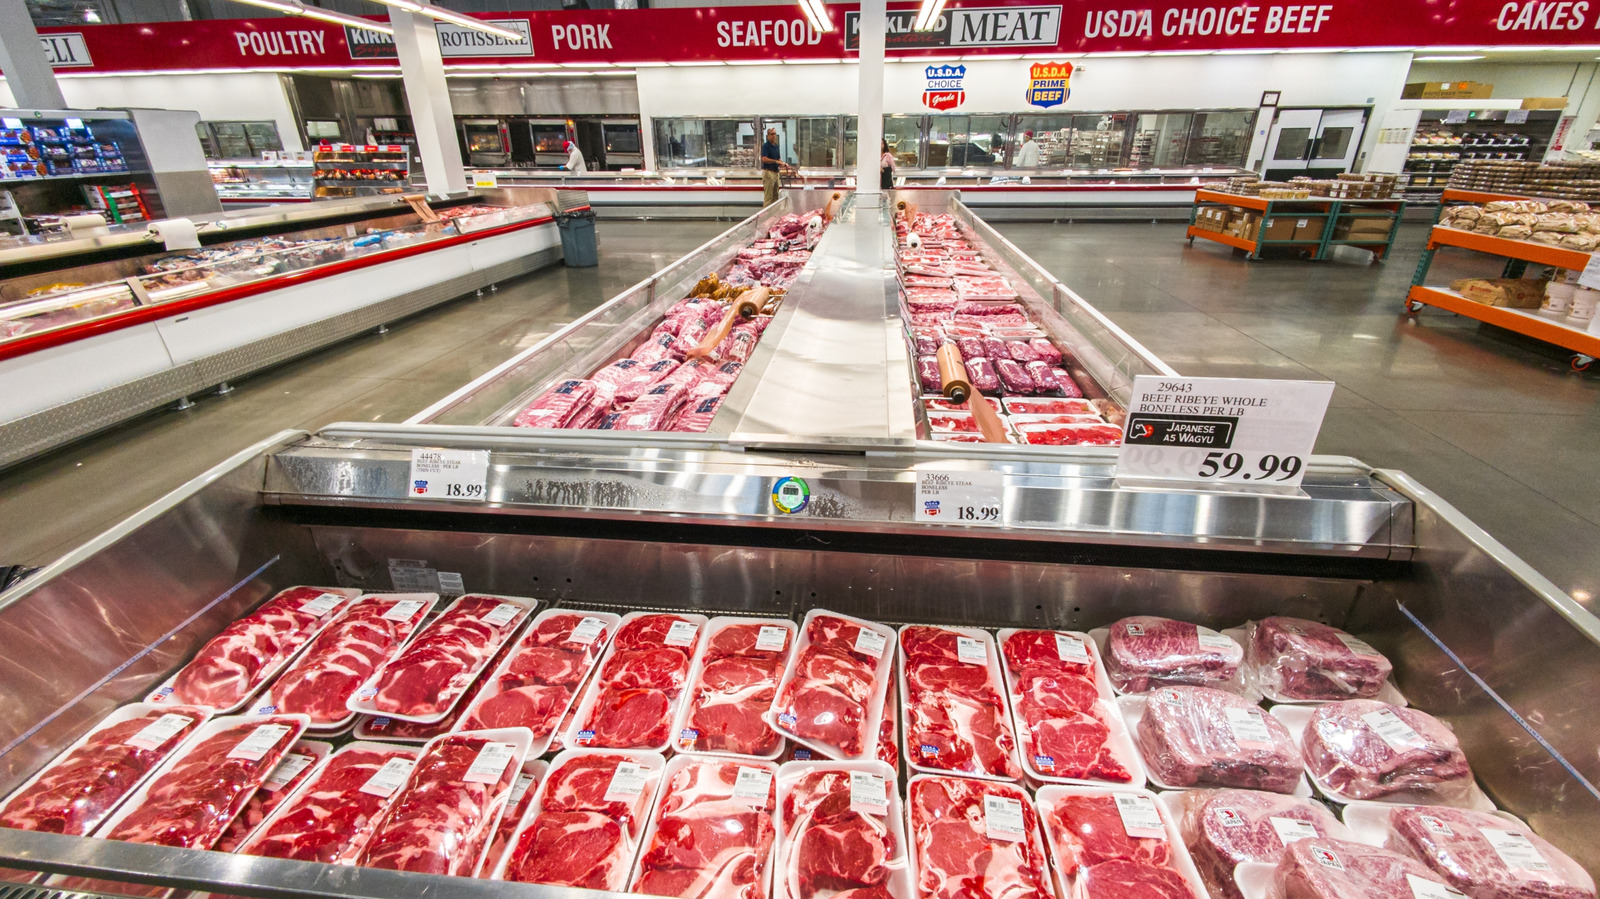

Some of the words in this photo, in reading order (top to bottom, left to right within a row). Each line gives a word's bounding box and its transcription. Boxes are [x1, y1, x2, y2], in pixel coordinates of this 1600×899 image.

[1084, 8, 1153, 39] USDA
[1161, 6, 1256, 37] CHOICE
[1264, 4, 1333, 34] BEEF
[1496, 1, 1590, 31] CAKES
[717, 19, 822, 48] SEAFOOD
[960, 11, 1050, 42] MEAT
[235, 30, 326, 56] POULTRY
[551, 24, 613, 50] PORK
[927, 68, 964, 78] U.S.D.A.
[1033, 67, 1069, 78] U.S.D.A.
[927, 79, 962, 89] CHOICE
[1033, 80, 1066, 88] PRIME
[931, 93, 956, 107] Grade
[1033, 91, 1062, 102] BEEF
[1157, 381, 1193, 393] 29643
[1141, 393, 1172, 403] BEEF
[1174, 395, 1218, 405] RIBEYE
[1221, 396, 1268, 407] WHOLE
[1139, 404, 1200, 415] BONELESS
[1202, 406, 1225, 416] PER
[1228, 406, 1245, 416] LB
[1163, 434, 1177, 443] A5
[1198, 451, 1303, 482] 59.99
[925, 473, 950, 481] 33666
[446, 483, 482, 497] 18.99
[957, 506, 999, 521] 18.99
